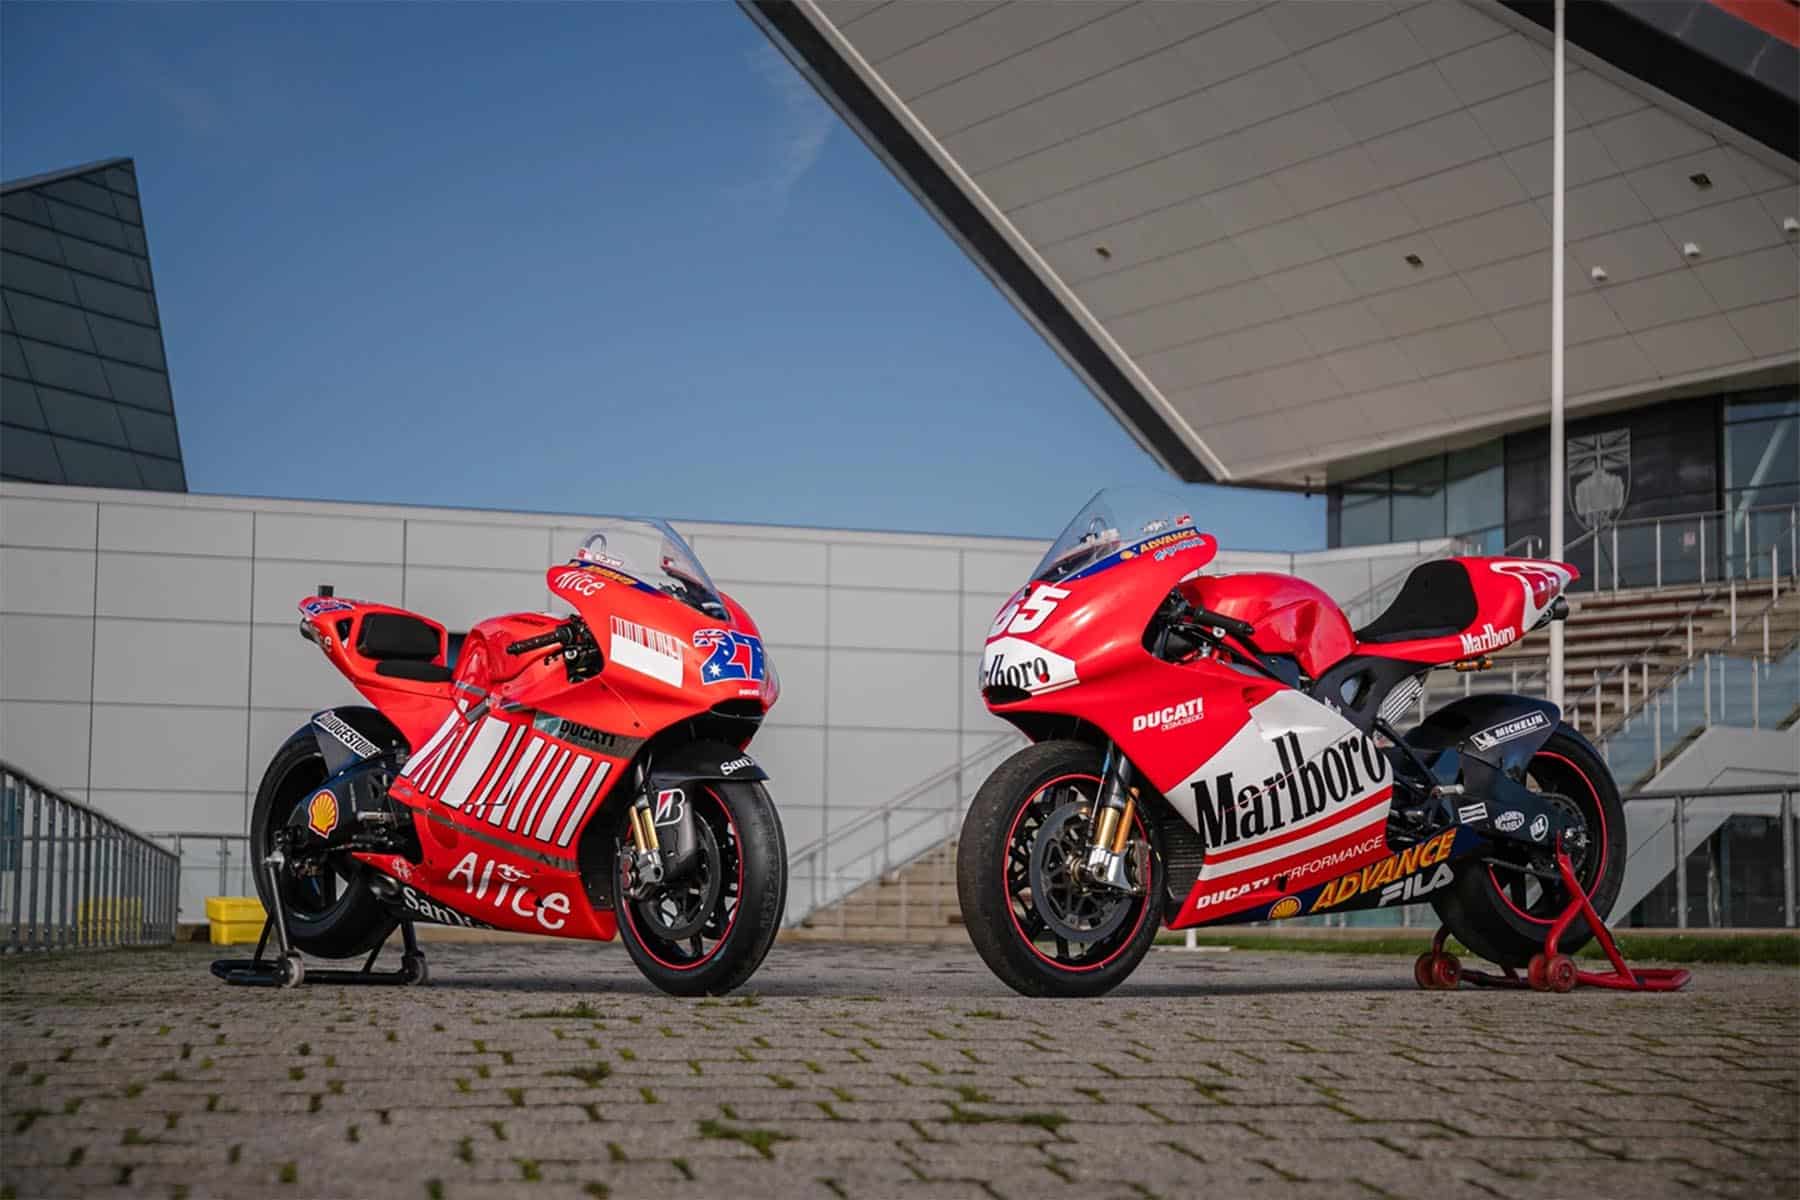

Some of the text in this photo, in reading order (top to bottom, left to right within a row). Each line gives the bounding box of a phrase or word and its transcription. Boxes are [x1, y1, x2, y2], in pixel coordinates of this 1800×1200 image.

[1460, 623, 1516, 655] Marlboro
[560, 719, 617, 747] DUCATI
[1132, 697, 1204, 733] DUCATI
[1495, 714, 1544, 738] MICHELIN
[1190, 730, 1387, 849] Marlboro
[1310, 827, 1457, 913] ADVANCE
[1377, 862, 1455, 907] FILA
[448, 851, 571, 930] Alice
[1196, 877, 1271, 910] DUCATI
